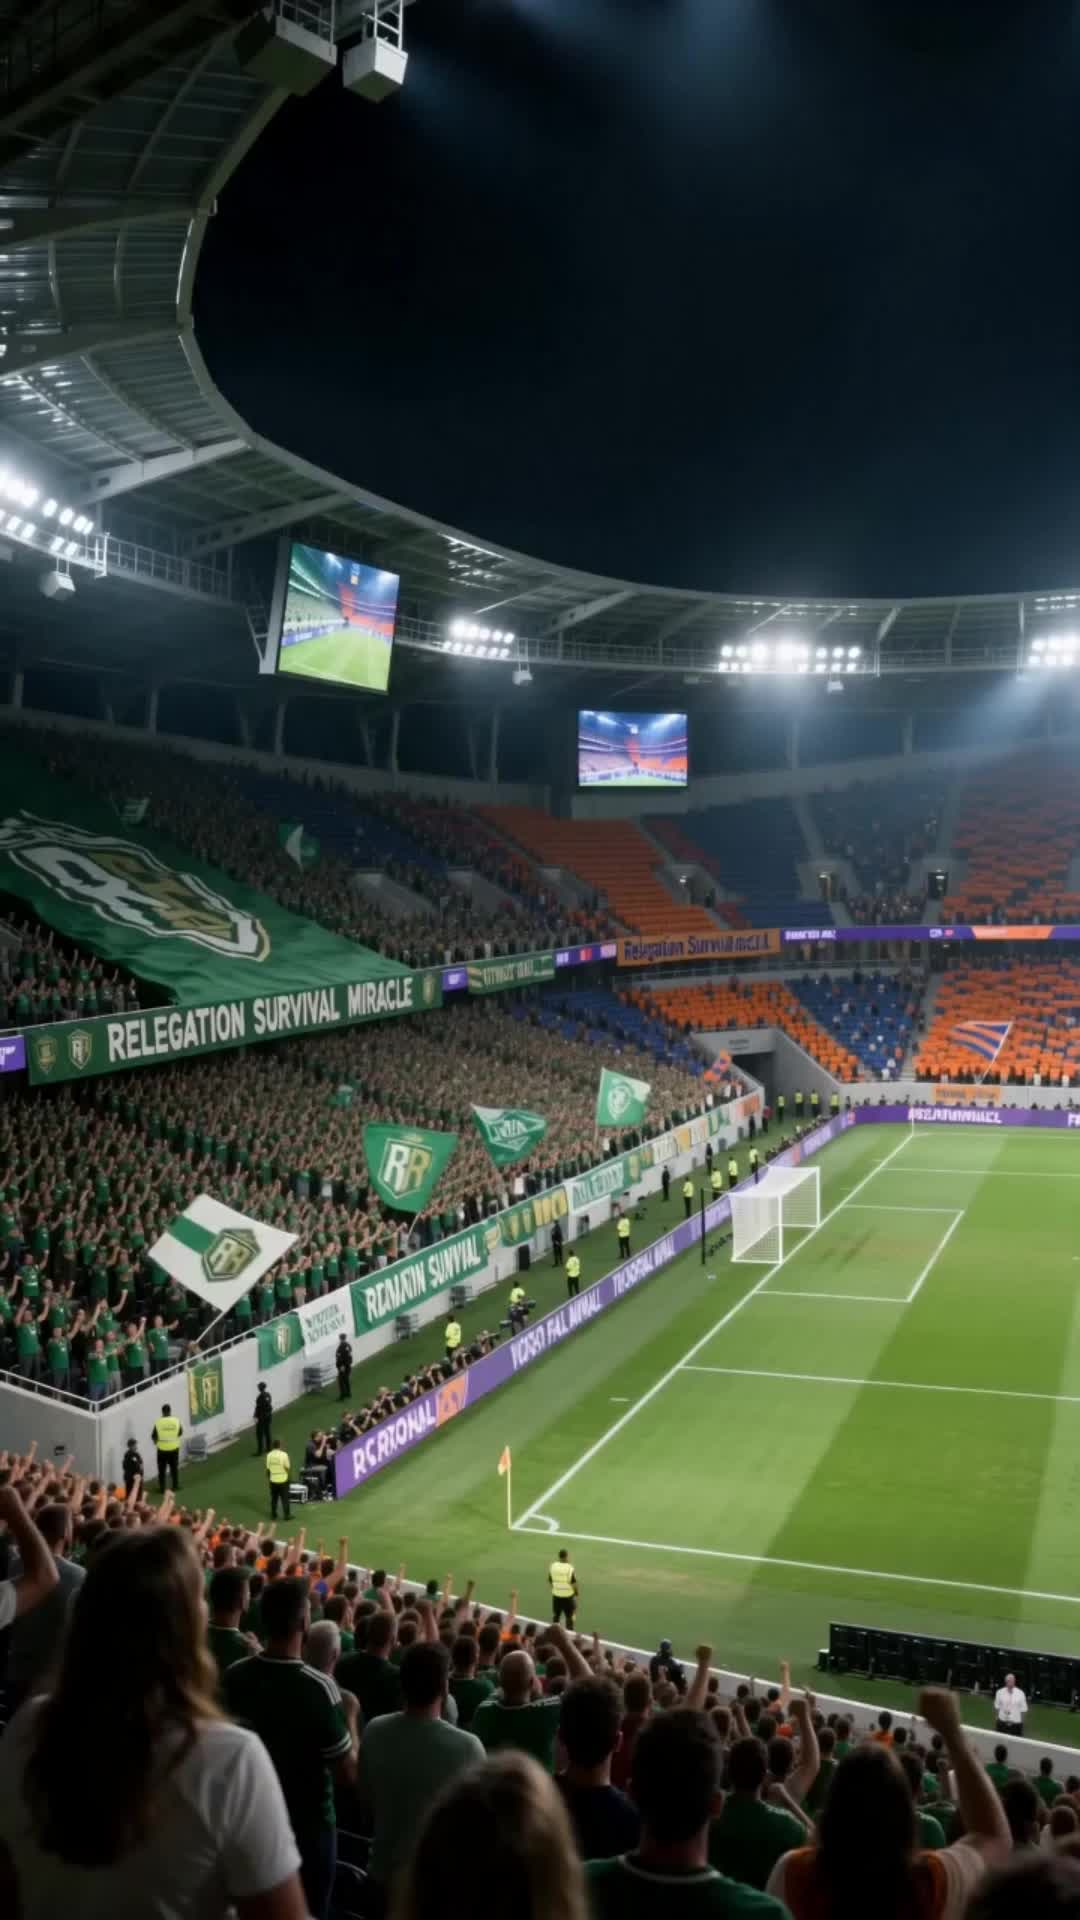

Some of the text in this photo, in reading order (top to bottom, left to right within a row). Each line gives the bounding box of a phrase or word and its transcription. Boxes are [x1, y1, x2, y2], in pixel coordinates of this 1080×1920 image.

[107, 1001, 246, 1063] RELEGATION
[253, 987, 341, 1035] SURVIVAL
[348, 977, 414, 1017] MIRACLE
